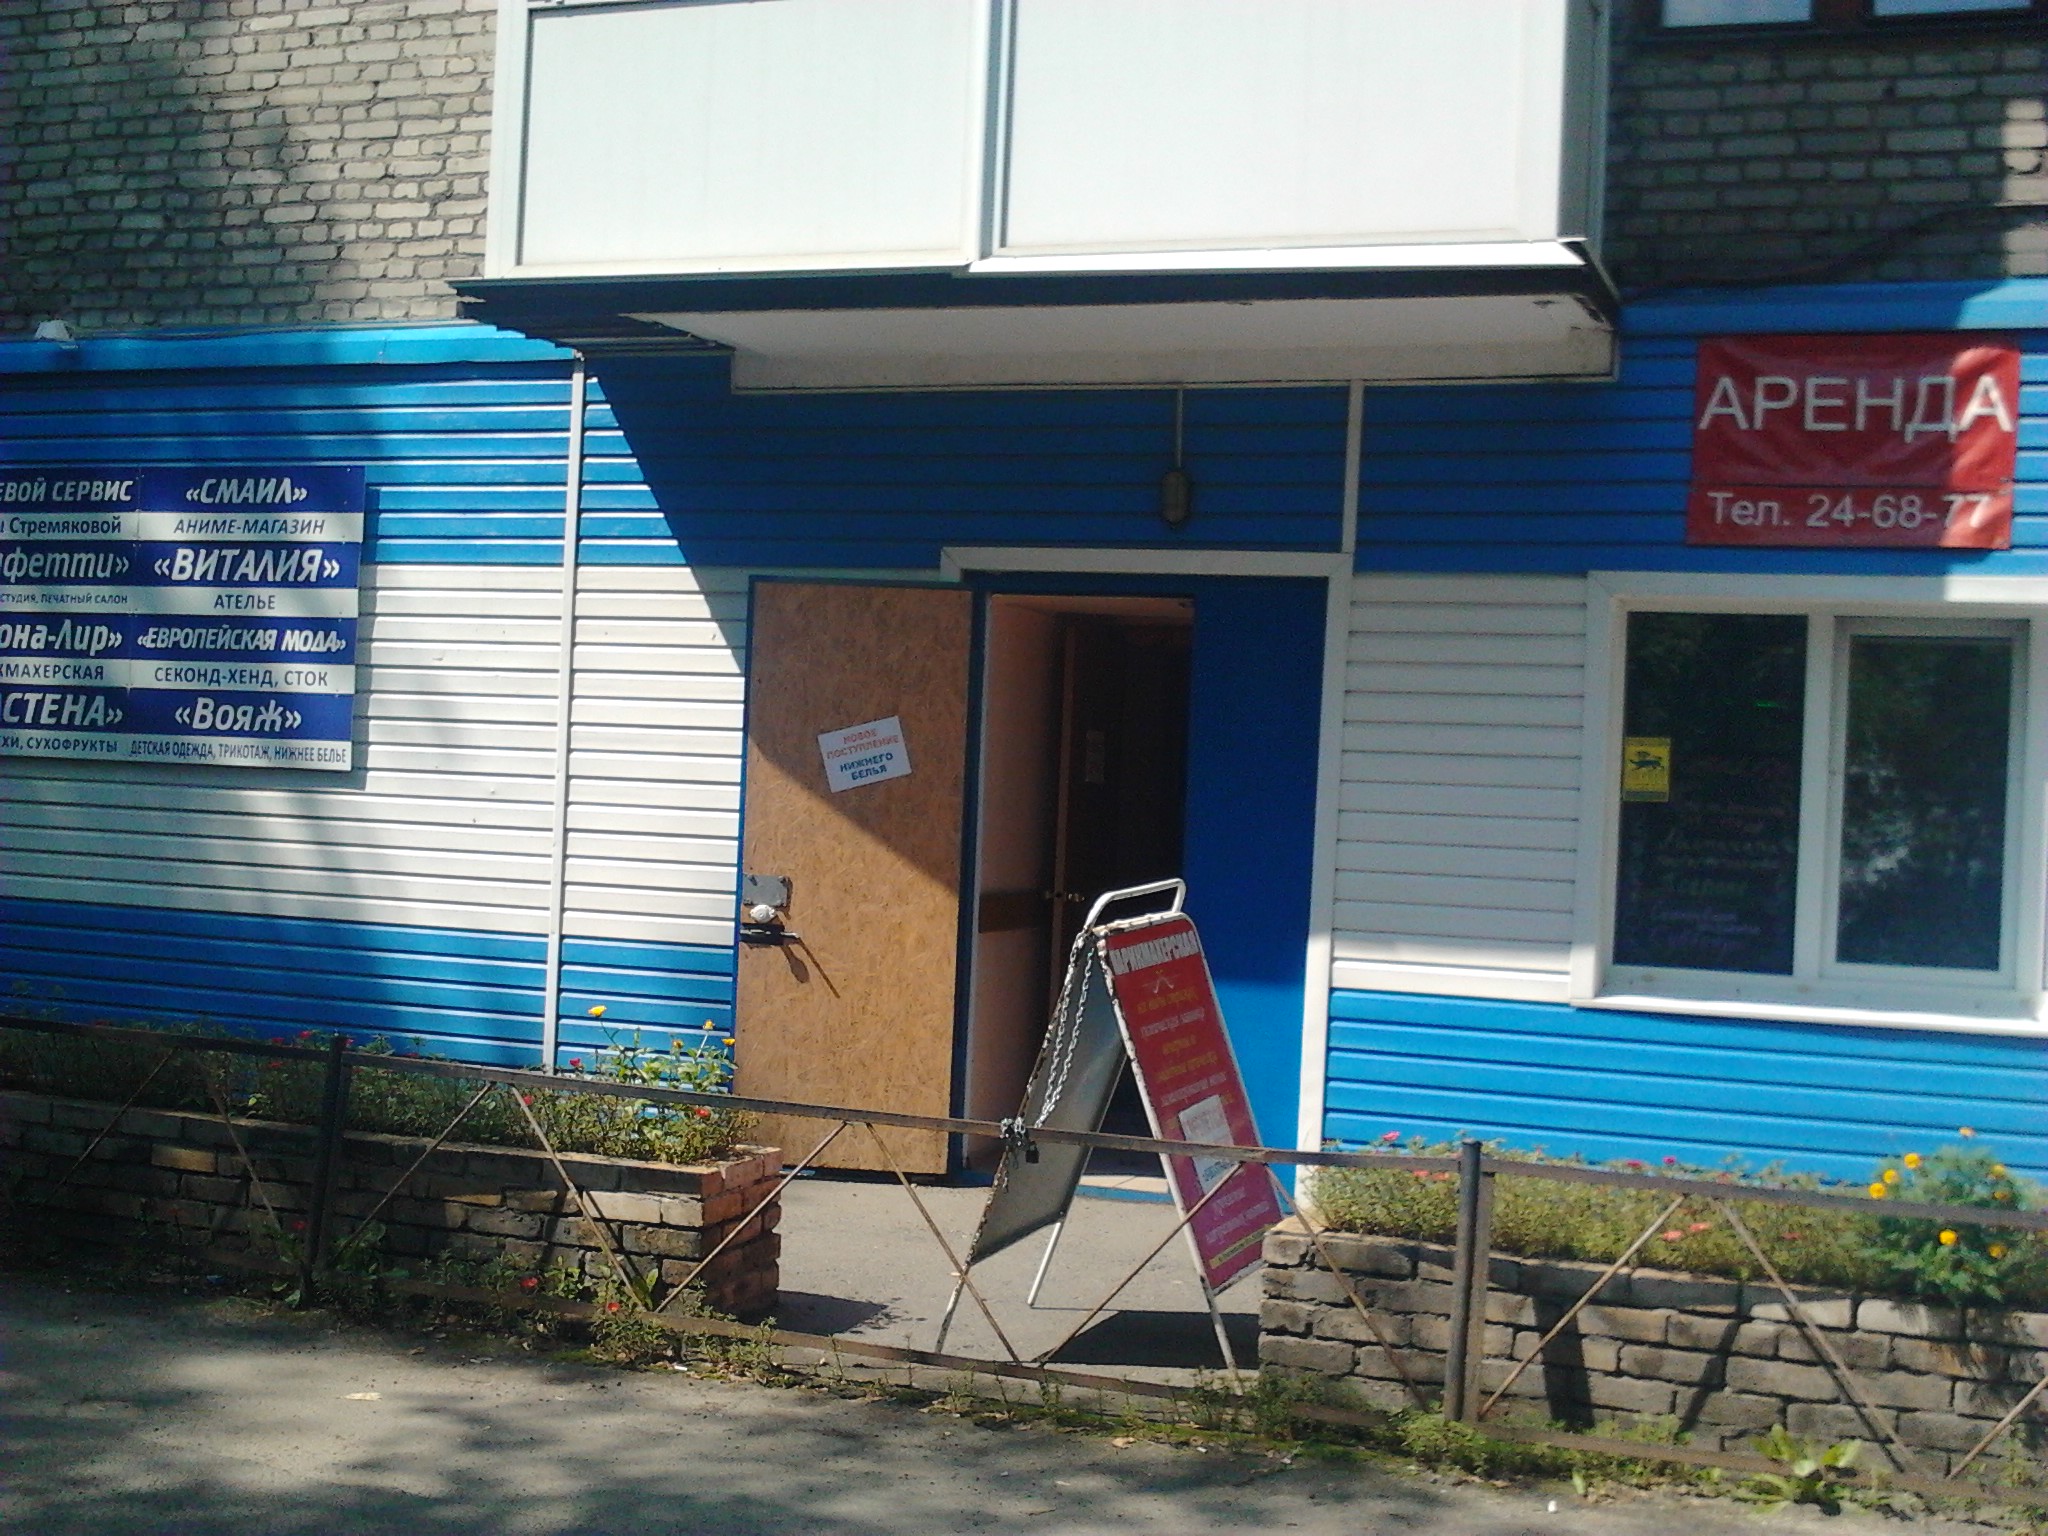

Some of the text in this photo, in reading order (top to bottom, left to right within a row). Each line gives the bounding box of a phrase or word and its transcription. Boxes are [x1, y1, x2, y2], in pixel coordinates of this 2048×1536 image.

[1698, 375, 2015, 443] АРЕНДА
[52, 480, 134, 502] СЕРВИС
[1707, 492, 1995, 529] Тел. 24-68-77
[10, 516, 121, 537] Стремяковой
[173, 519, 326, 534] АНИМЕ-МАГАЗИН
[0, 546, 129, 583] фетти»
[154, 548, 340, 582] «ВИТАЛИЯ»
[41, 593, 92, 604] ПЕЧАТНЫЙ
[94, 594, 128, 604] САЛОН
[214, 595, 276, 610] АТЕЛЬЕ
[137, 624, 347, 652] «ЕВРОПЕЙСКАЯ МОДА»
[155, 667, 328, 688] СЕКОНД-ХЕНД, СТОК
[0, 692, 124, 726] СТЕНА»
[27, 736, 118, 753] СУХОФРУКТЫ
[130, 740, 347, 763] ДЕТСКАЯ ОДЕЖДА, ТРИКОТАЖ, НИЖНЕЕ БЕЛЬЕ
[840, 753, 894, 772] НИЖНЕГО
[851, 765, 887, 780] БЕЛЬЯ
